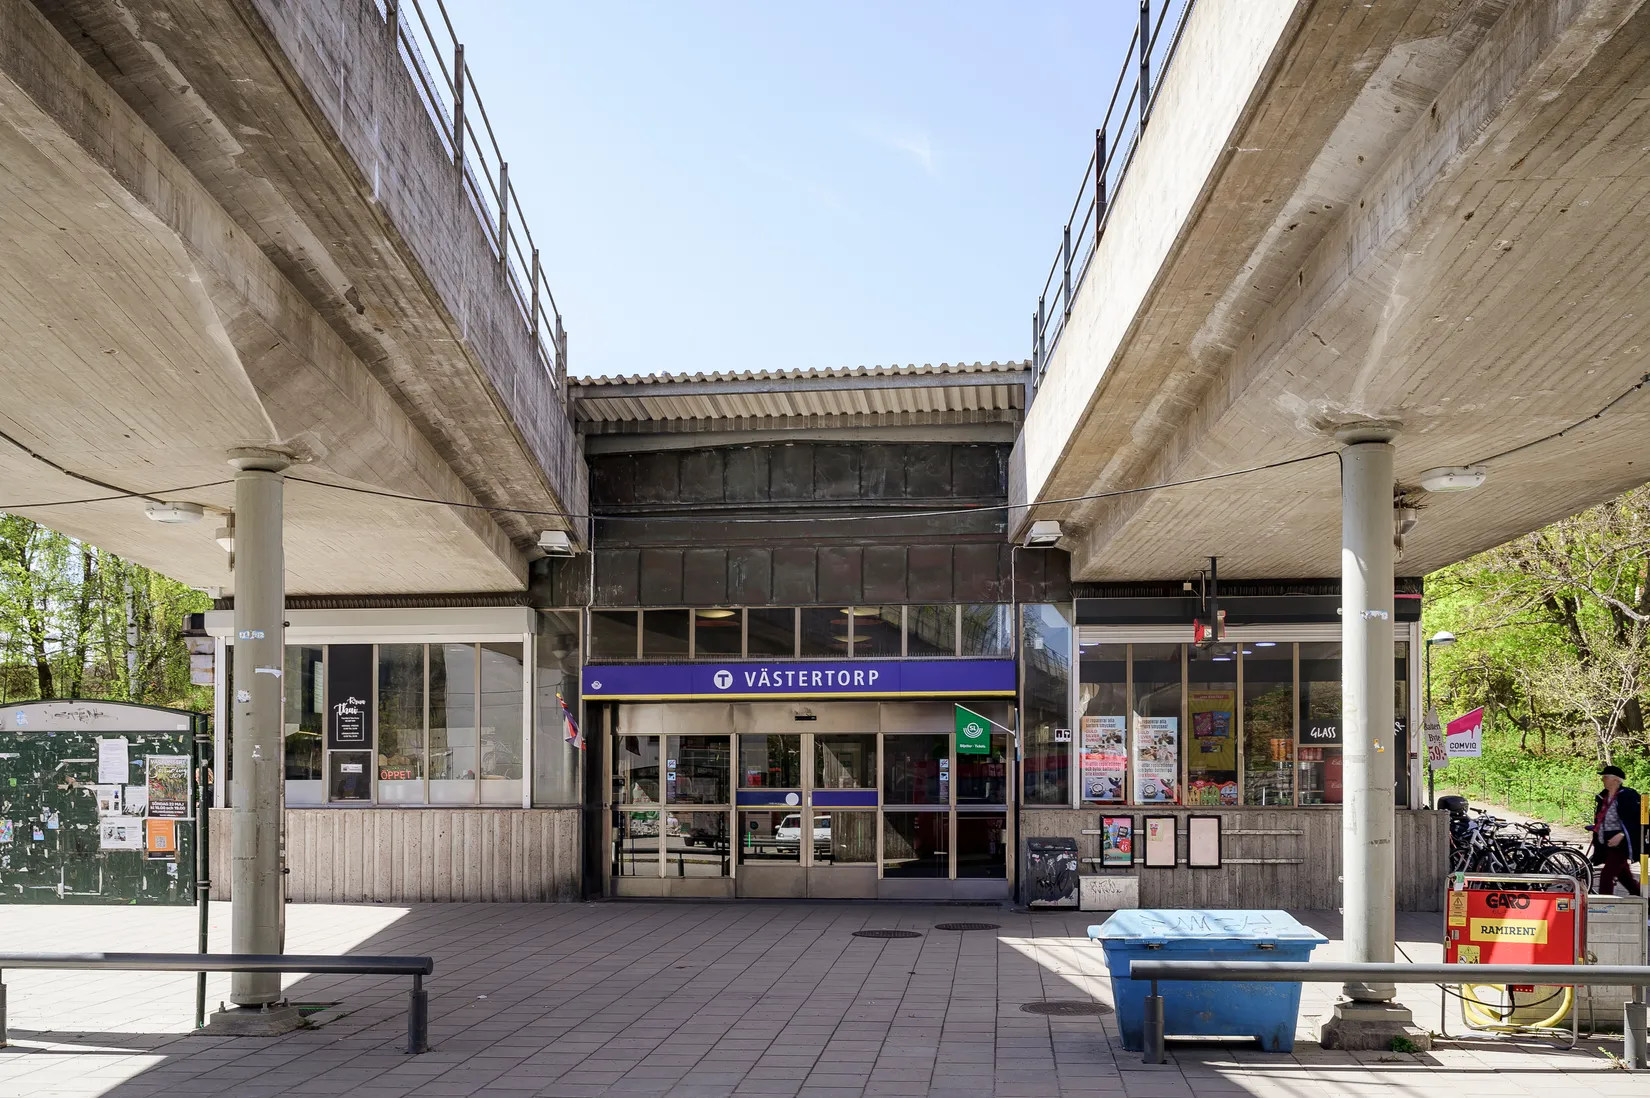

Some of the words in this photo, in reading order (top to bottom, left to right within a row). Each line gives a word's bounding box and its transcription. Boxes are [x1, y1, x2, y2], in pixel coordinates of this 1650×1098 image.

[744, 668, 879, 687] VÄSTERTORP
[1310, 727, 1336, 738] GLASS
[1428, 734, 1441, 743] Byte
[1449, 742, 1477, 750] COMVIQ
[380, 769, 411, 780] ÖPPET
[1485, 893, 1530, 909] GARO
[1481, 926, 1536, 936] RAMIRENT
